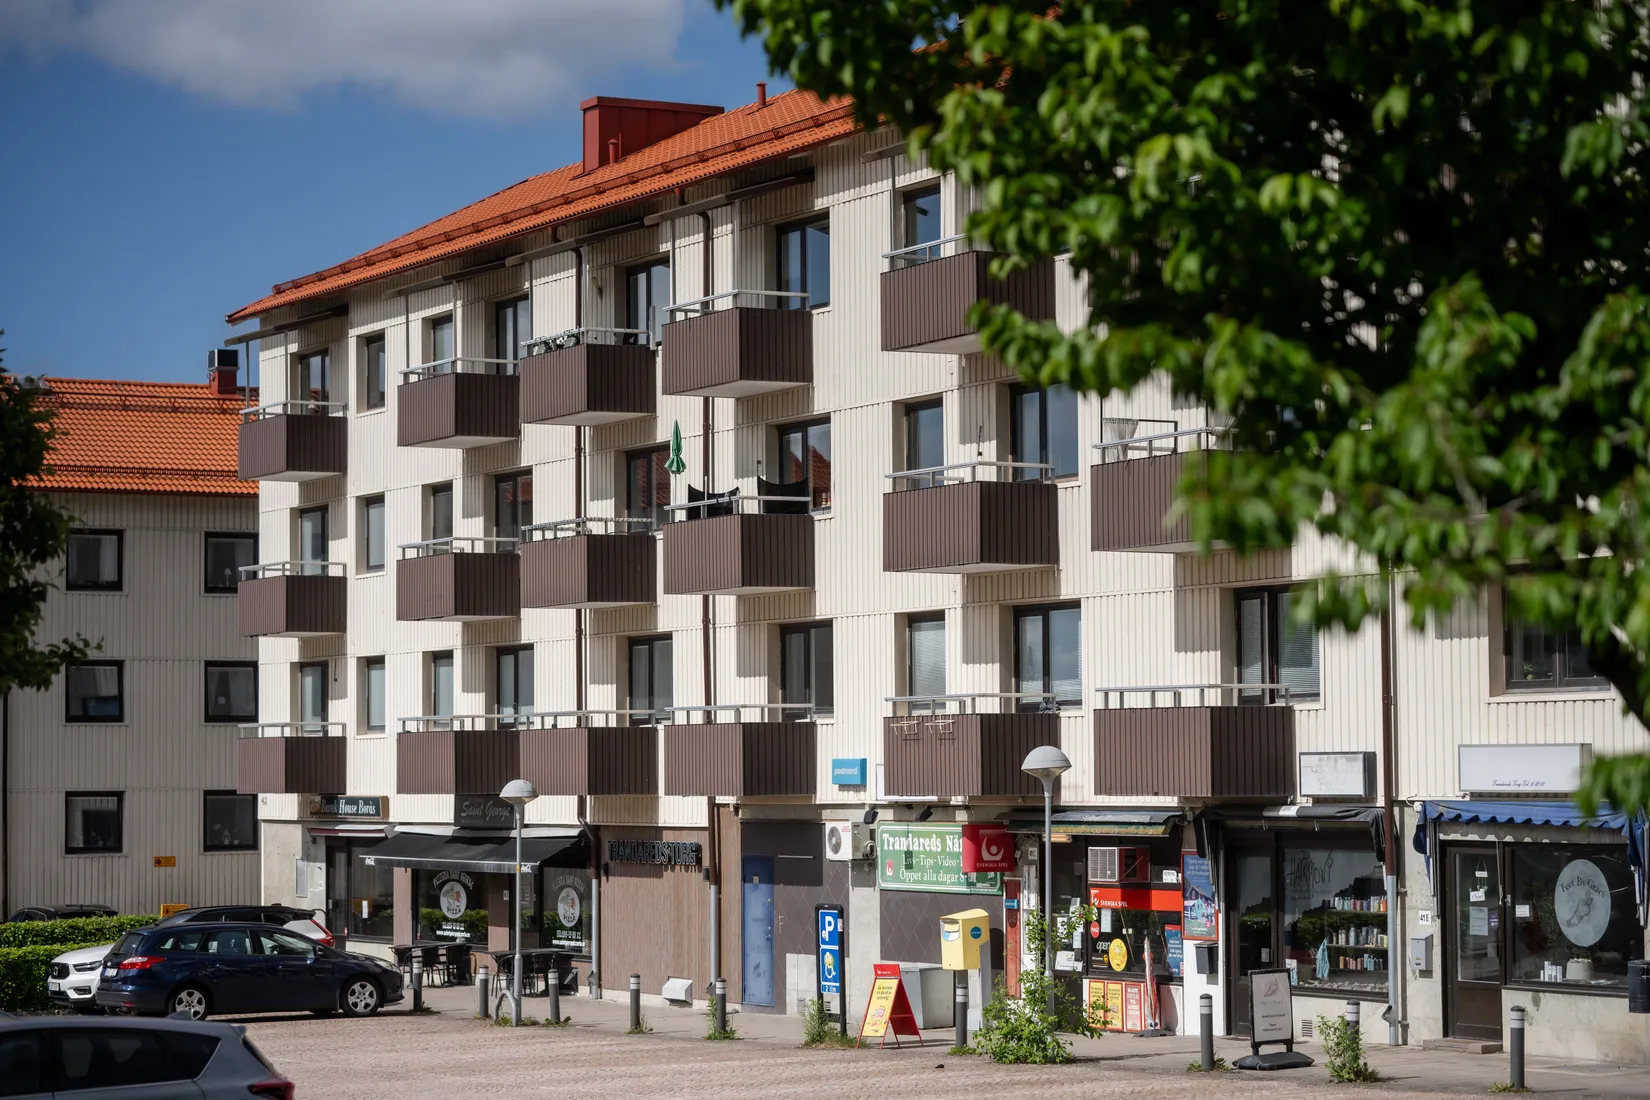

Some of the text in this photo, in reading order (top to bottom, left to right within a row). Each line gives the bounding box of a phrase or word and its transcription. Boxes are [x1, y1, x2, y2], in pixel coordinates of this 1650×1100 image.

[339, 800, 357, 815] House
[359, 800, 376, 814] Borås
[461, 800, 511, 821] Saint George
[606, 839, 698, 865] TRANDAREDS TORG
[882, 833, 942, 853] Trandareds
[900, 866, 922, 883] Öppet
[923, 869, 937, 883] alla
[938, 871, 959, 885] dagar
[1560, 875, 1606, 899] Feet By Grace
[825, 915, 835, 942] P
